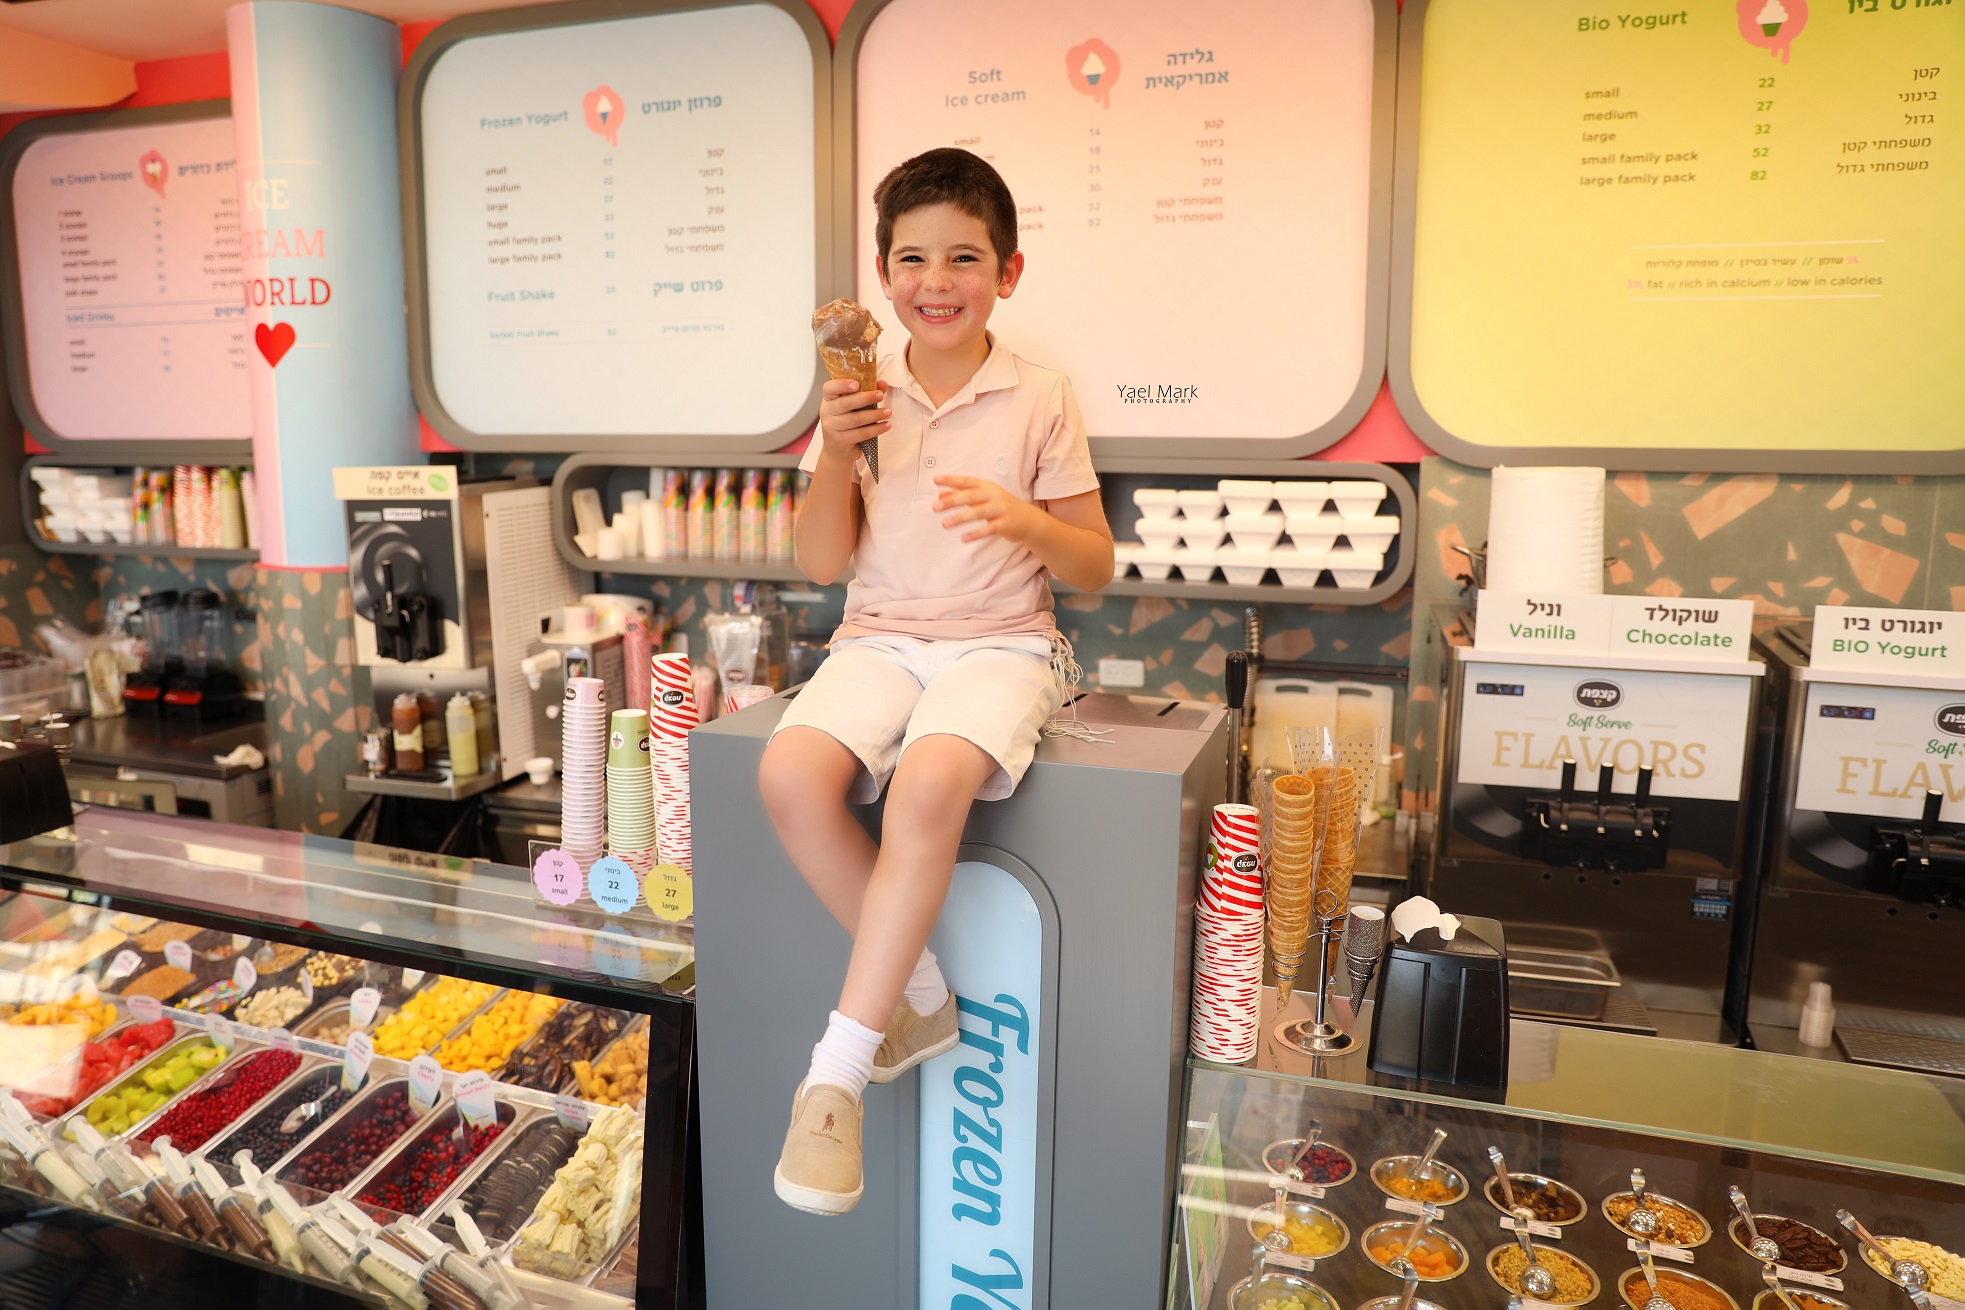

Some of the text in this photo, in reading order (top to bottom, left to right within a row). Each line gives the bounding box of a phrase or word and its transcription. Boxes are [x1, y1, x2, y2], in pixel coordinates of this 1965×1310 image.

[1578, 11, 1687, 31] Bio Yogurt
[1166, 49, 1214, 66] גלידה
[968, 68, 1002, 84] Soft
[1144, 71, 1230, 91] אמריקאית
[1913, 67, 1941, 81] קטן
[1758, 77, 1775, 89] 22
[945, 90, 1026, 108] Ice cream
[1584, 88, 1620, 99] small
[1898, 90, 1938, 103] בינוני
[642, 95, 723, 114] פרוזן יוגורט
[1756, 101, 1773, 111] 27
[480, 110, 569, 130] Frozen Yogurt
[1583, 109, 1638, 121] medium
[1904, 113, 1935, 125] גדול
[1754, 124, 1771, 135] 32
[1582, 133, 1616, 144] large
[1841, 136, 1932, 153] משפחתי קטן
[1580, 151, 1699, 166] small family pack
[1752, 147, 1769, 158] 52
[1836, 160, 1930, 174] משפחתי גדול
[1579, 172, 1697, 187] large family pack
[1750, 170, 1767, 181] 82
[245, 178, 289, 212] ICE
[241, 227, 326, 260] REAM
[1679, 278, 1702, 289] rich
[1706, 279, 1718, 288] in
[1721, 277, 1771, 288] calcium
[1787, 276, 1810, 287] low
[1814, 276, 1826, 286] in
[1830, 274, 1883, 286] calories
[388, 484, 425, 496] coffee
[1526, 598, 1562, 617] וניל
[1644, 604, 1719, 627] שוקולד
[1509, 623, 1576, 641] Vanilla
[1843, 616, 1943, 634] יוגורט ביו
[1626, 628, 1733, 648] Chocolate
[1832, 639, 1947, 659] BIO Yogurt
[1579, 686, 1618, 701] קצפת
[1566, 713, 1632, 732] Soft Serve
[1491, 730, 1708, 780] FLAVORS
[1925, 738, 1958, 759] Soft
[552, 860, 564, 868] קטן
[605, 866, 621, 876] בינוני
[553, 874, 564, 883] 17
[608, 880, 619, 890] 22
[663, 874, 677, 883] גדול
[551, 887, 568, 896] small
[665, 888, 677, 898] 27
[601, 894, 629, 905] medium
[662, 901, 679, 912] large
[950, 993, 1030, 1227] Frozen
